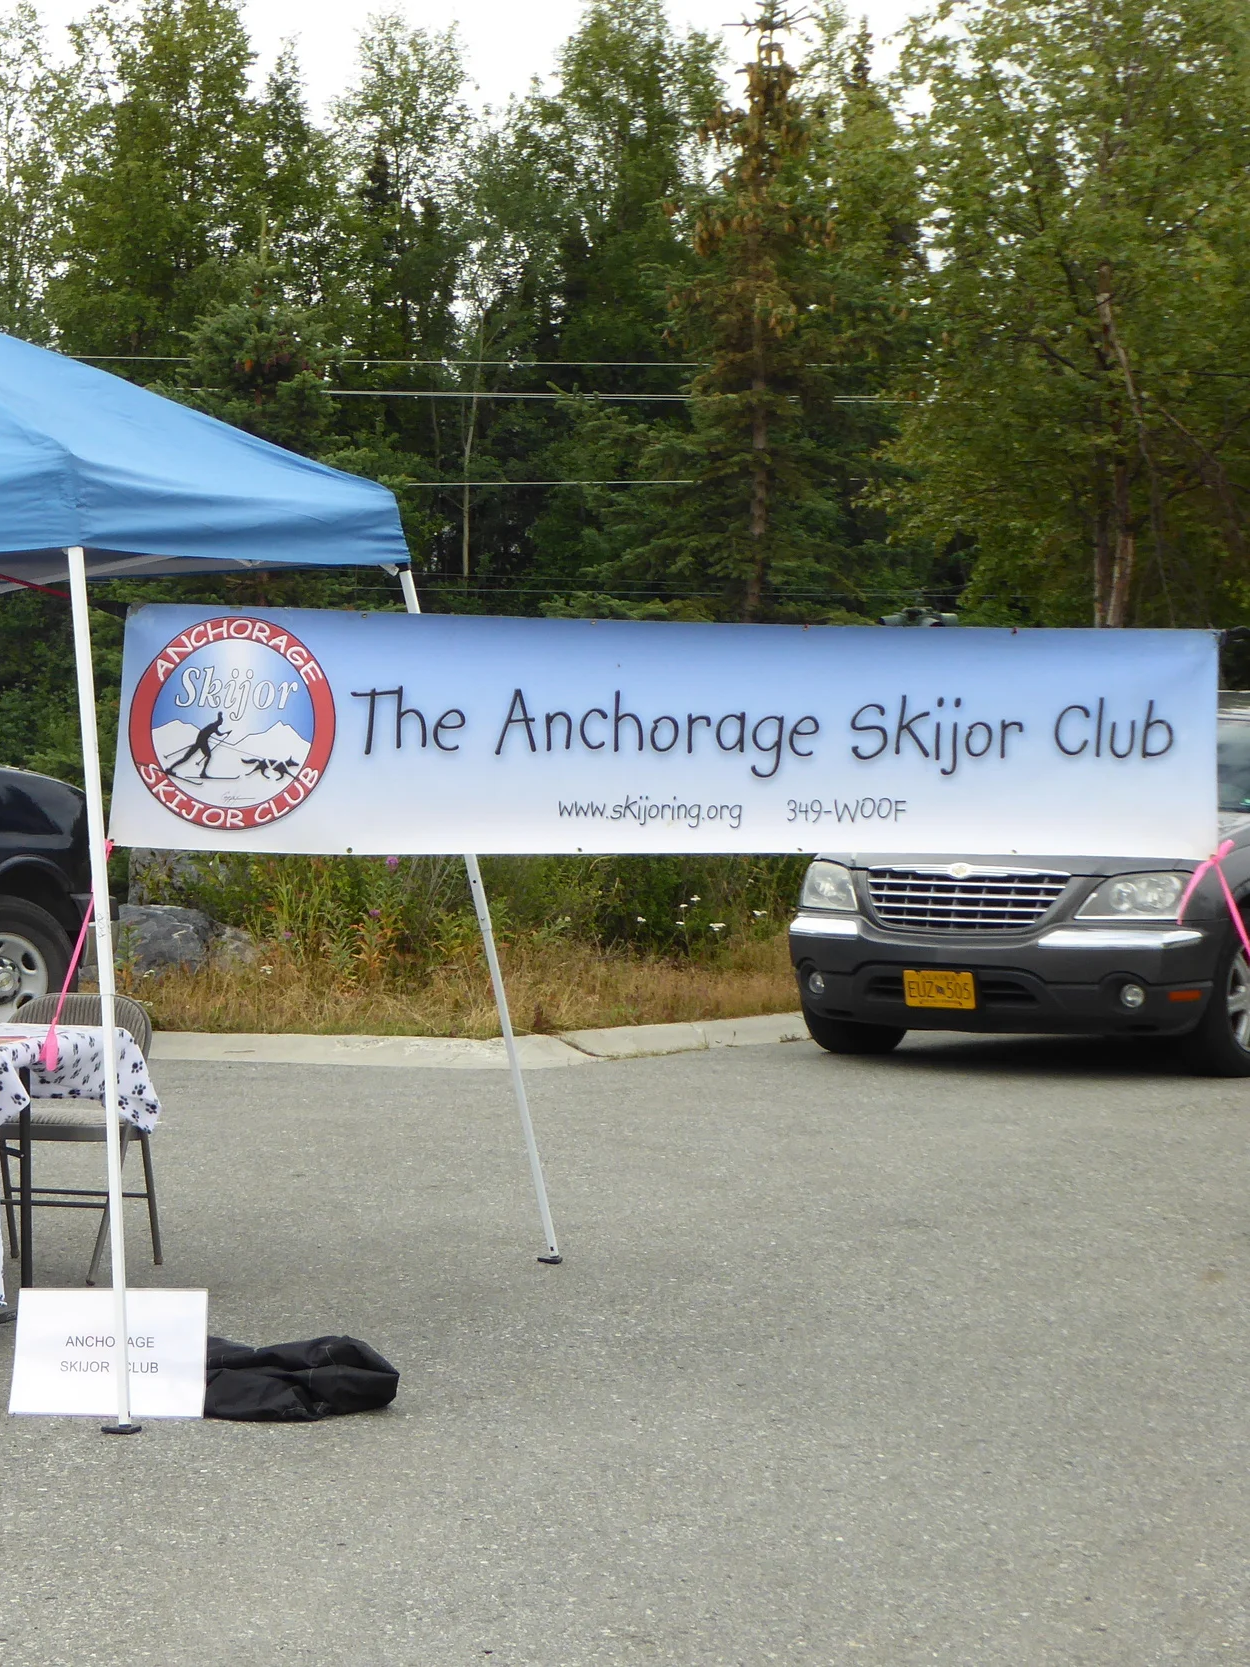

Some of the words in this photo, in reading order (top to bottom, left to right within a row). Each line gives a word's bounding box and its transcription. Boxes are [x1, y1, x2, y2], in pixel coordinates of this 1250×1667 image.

[156, 618, 323, 685] ANCHORAGE
[175, 666, 299, 721] Skijor
[350, 685, 466, 755] The
[494, 688, 820, 778] Anchorage
[850, 695, 1024, 776] Skijor
[1054, 696, 1175, 759] Club
[139, 764, 245, 827] SKIJOR
[254, 767, 320, 823] CLUB
[558, 794, 743, 828] www.skijoring.org
[786, 797, 907, 823] 349-WOOF
[908, 981, 935, 998] EUZ
[946, 982, 971, 1000] 505
[65, 1335, 155, 1348] ANCHOAGE
[59, 1361, 110, 1373] SKIJOR
